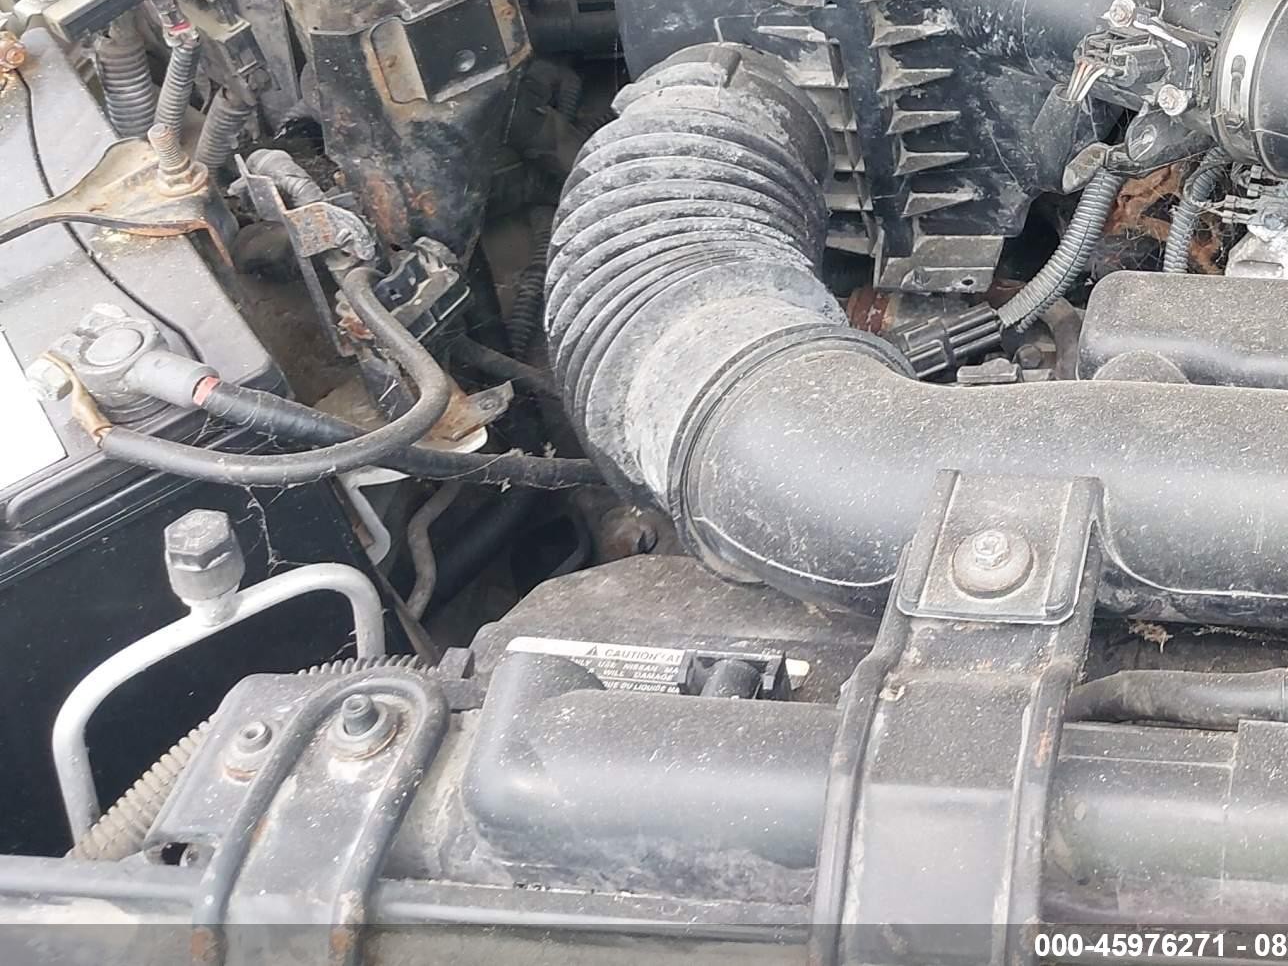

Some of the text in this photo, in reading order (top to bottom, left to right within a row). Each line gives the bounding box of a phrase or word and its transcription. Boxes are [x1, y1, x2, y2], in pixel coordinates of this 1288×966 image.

[604, 648, 657, 661] CAUTION
[622, 663, 660, 672] NISSAN
[632, 672, 675, 682] DAMAGE
